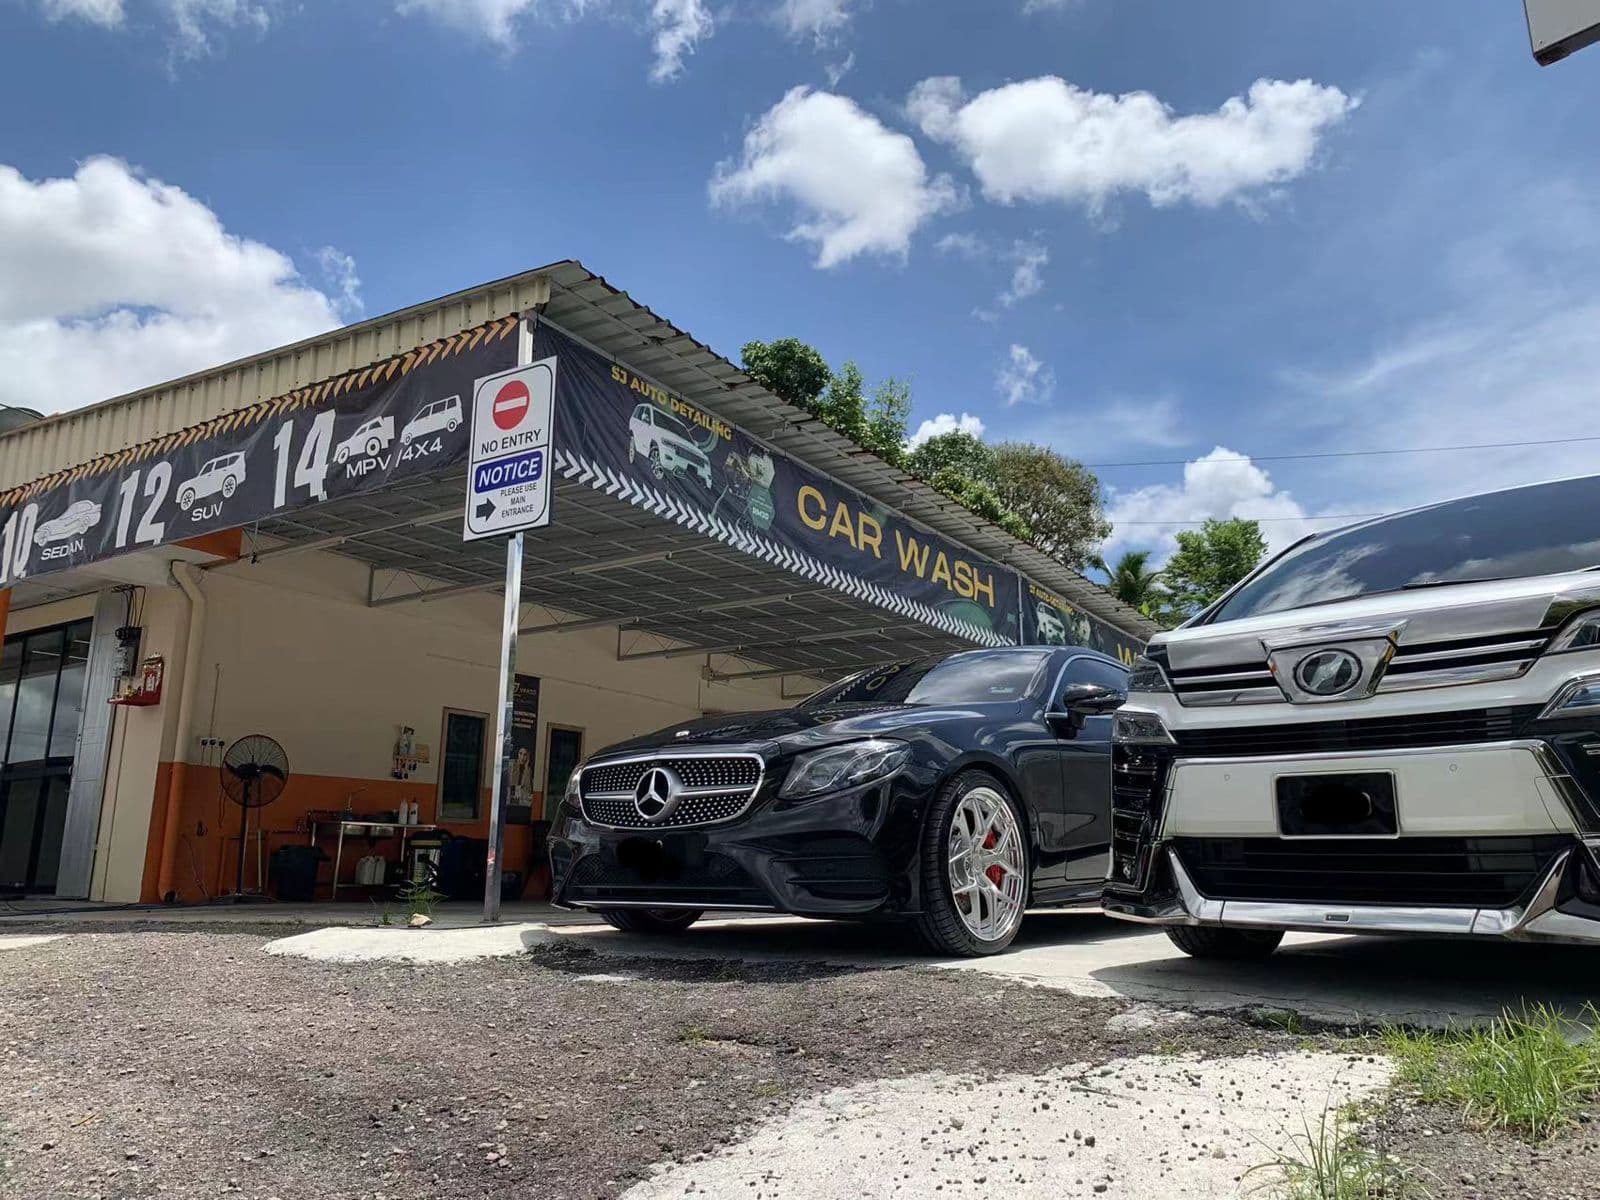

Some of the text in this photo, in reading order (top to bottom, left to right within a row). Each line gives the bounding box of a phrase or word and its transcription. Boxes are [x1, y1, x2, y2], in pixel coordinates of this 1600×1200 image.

[611, 365, 733, 441] SJ AUTO DETAILING
[481, 429, 542, 455] NO ENTRY
[273, 409, 336, 510] 14
[346, 455, 392, 479] MPV
[478, 458, 540, 487] NOTICE
[500, 482, 537, 496] PLEASE USE
[510, 495, 526, 505] MAIN
[115, 461, 173, 548] 12
[191, 502, 223, 522] SUV
[501, 504, 534, 518] ENTRANCE
[0, 503, 38, 584] 10
[40, 539, 84, 560] SEDAN
[797, 485, 995, 608] CAR WASH
